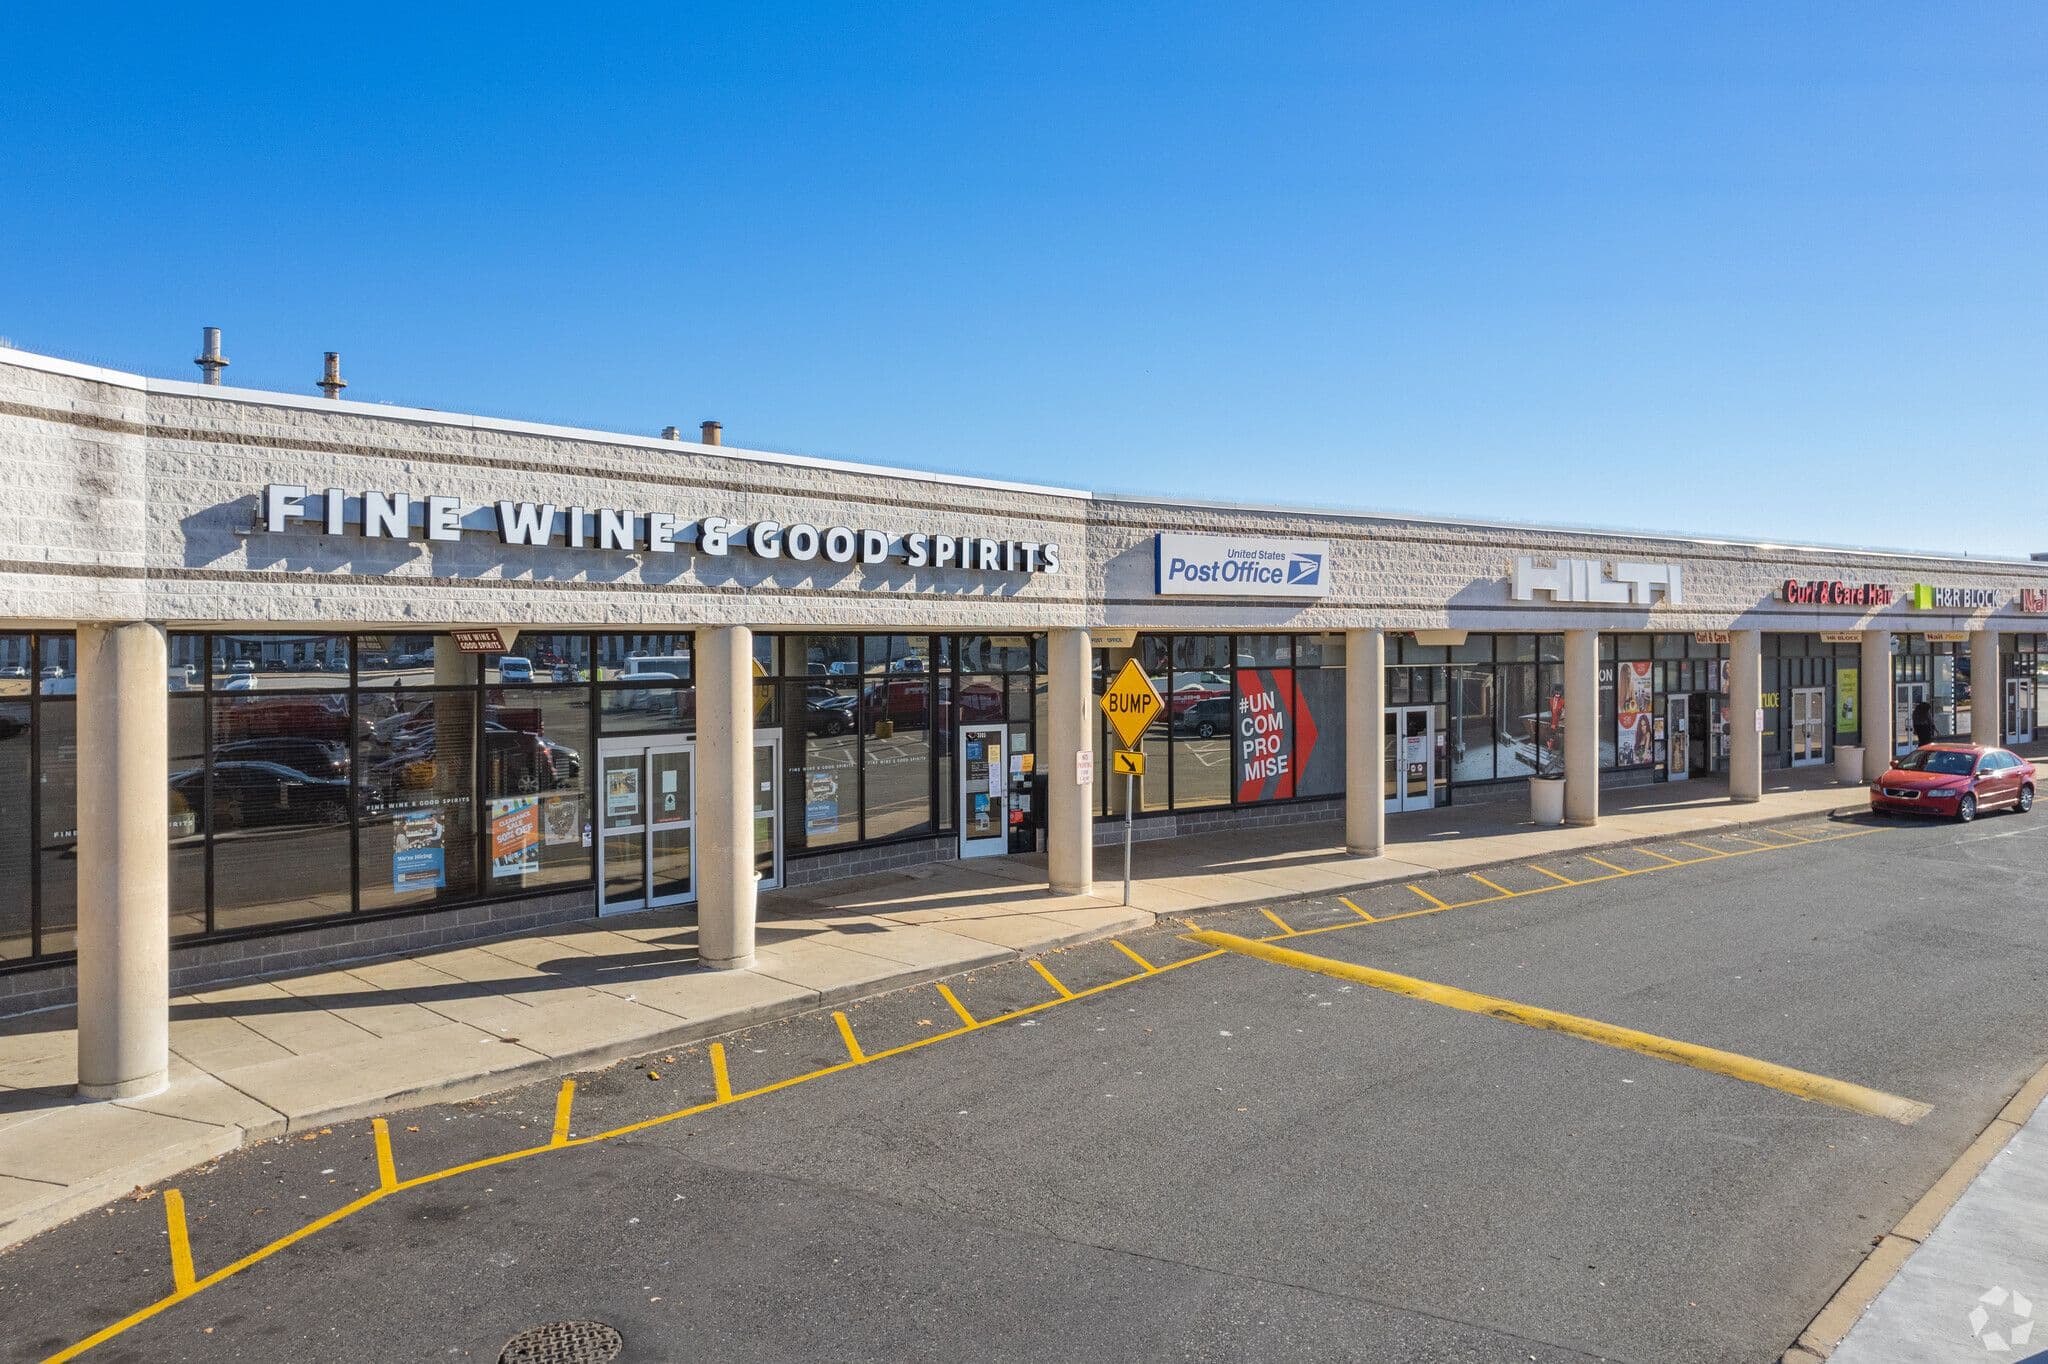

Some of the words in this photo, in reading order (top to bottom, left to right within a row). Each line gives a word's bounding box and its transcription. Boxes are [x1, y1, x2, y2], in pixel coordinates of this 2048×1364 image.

[266, 484, 461, 541] FINE
[496, 500, 676, 552] WINE
[699, 517, 728, 556] &
[750, 520, 889, 564] GOOD
[903, 533, 1060, 574] SPIRITS
[1227, 549, 1257, 559] United
[1258, 550, 1286, 561] States
[1168, 558, 1220, 582] Post
[1221, 559, 1283, 584] Office
[1514, 556, 1682, 605] HILTI
[1785, 579, 1817, 603] Curl
[1819, 580, 1829, 604] &
[1833, 581, 1864, 605] Care
[1866, 584, 1893, 605] Hair
[1936, 587, 1960, 608] H&R
[1963, 587, 2000, 608] BLOCK
[2022, 588, 2048, 613] Nai
[478, 641, 501, 649] SPIRITS
[1715, 631, 1726, 641] Care
[1109, 692, 1152, 713] BUMP
[1239, 691, 1275, 714] #UN
[1241, 711, 1284, 736] COM
[1243, 734, 1280, 759] PRO
[1244, 755, 1289, 781] MISE
[388, 801, 408, 809] WINE
